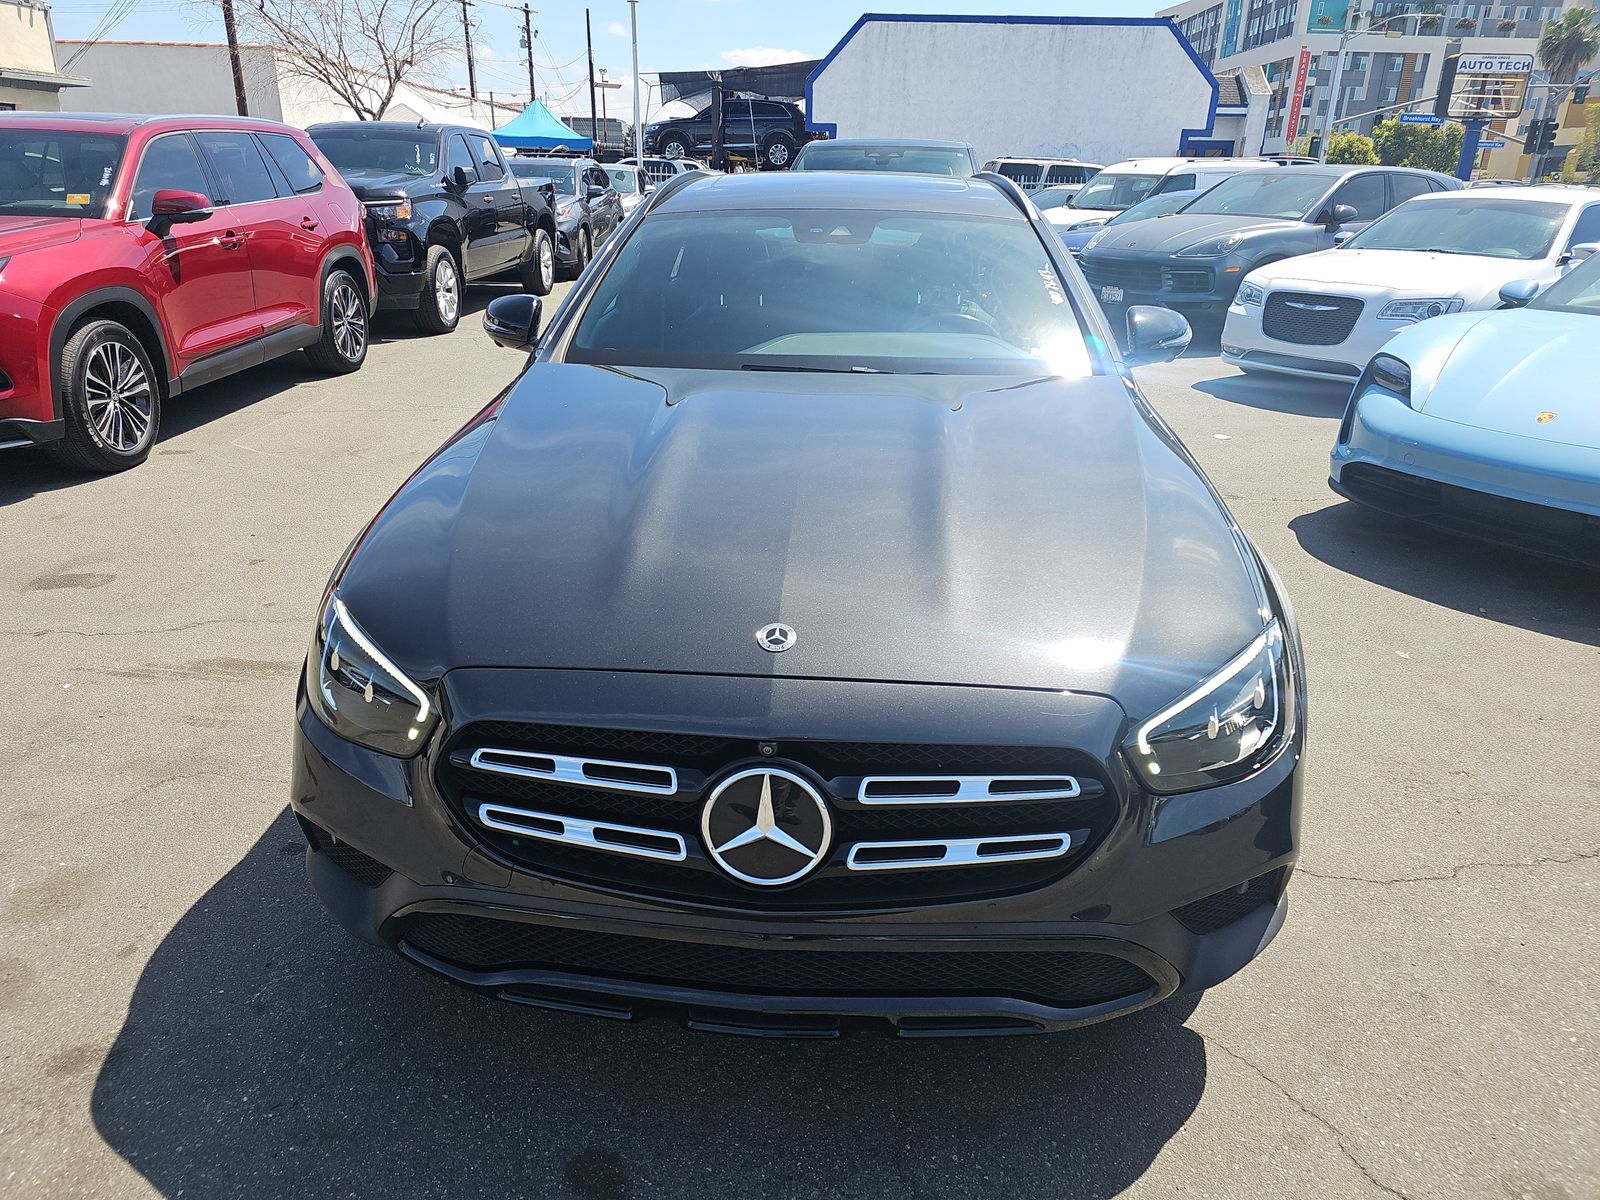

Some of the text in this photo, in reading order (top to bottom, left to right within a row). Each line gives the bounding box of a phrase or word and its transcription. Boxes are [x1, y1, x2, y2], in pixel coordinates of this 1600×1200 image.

[1297, 52, 1308, 92] LEASING
[1459, 60, 1531, 71] AUTO TECH
